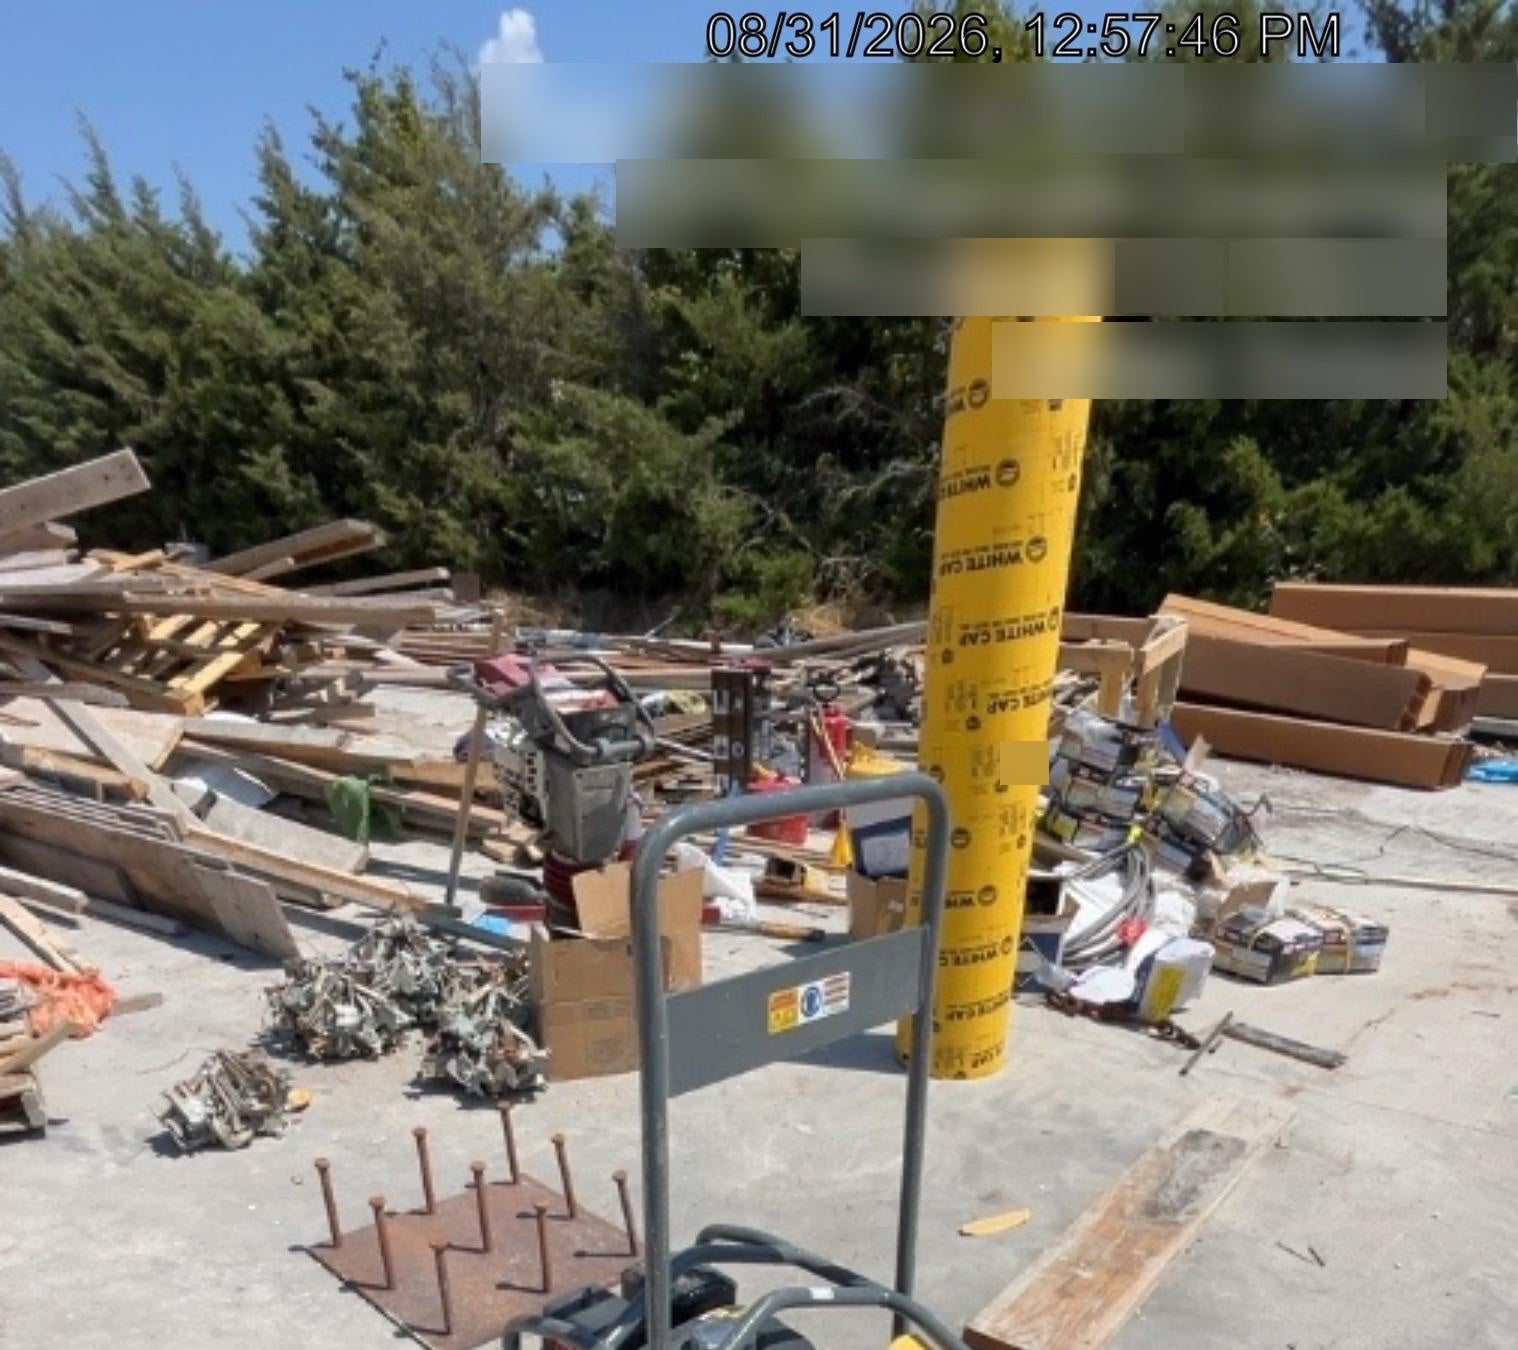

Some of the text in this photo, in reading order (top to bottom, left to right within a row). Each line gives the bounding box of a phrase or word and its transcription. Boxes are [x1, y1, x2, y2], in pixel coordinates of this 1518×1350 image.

[966, 551, 1023, 572] WHITE
[959, 629, 991, 647] CAP
[995, 620, 1045, 643] WHITE
[987, 698, 1020, 715] CAP
[952, 949, 999, 967] WHITE
